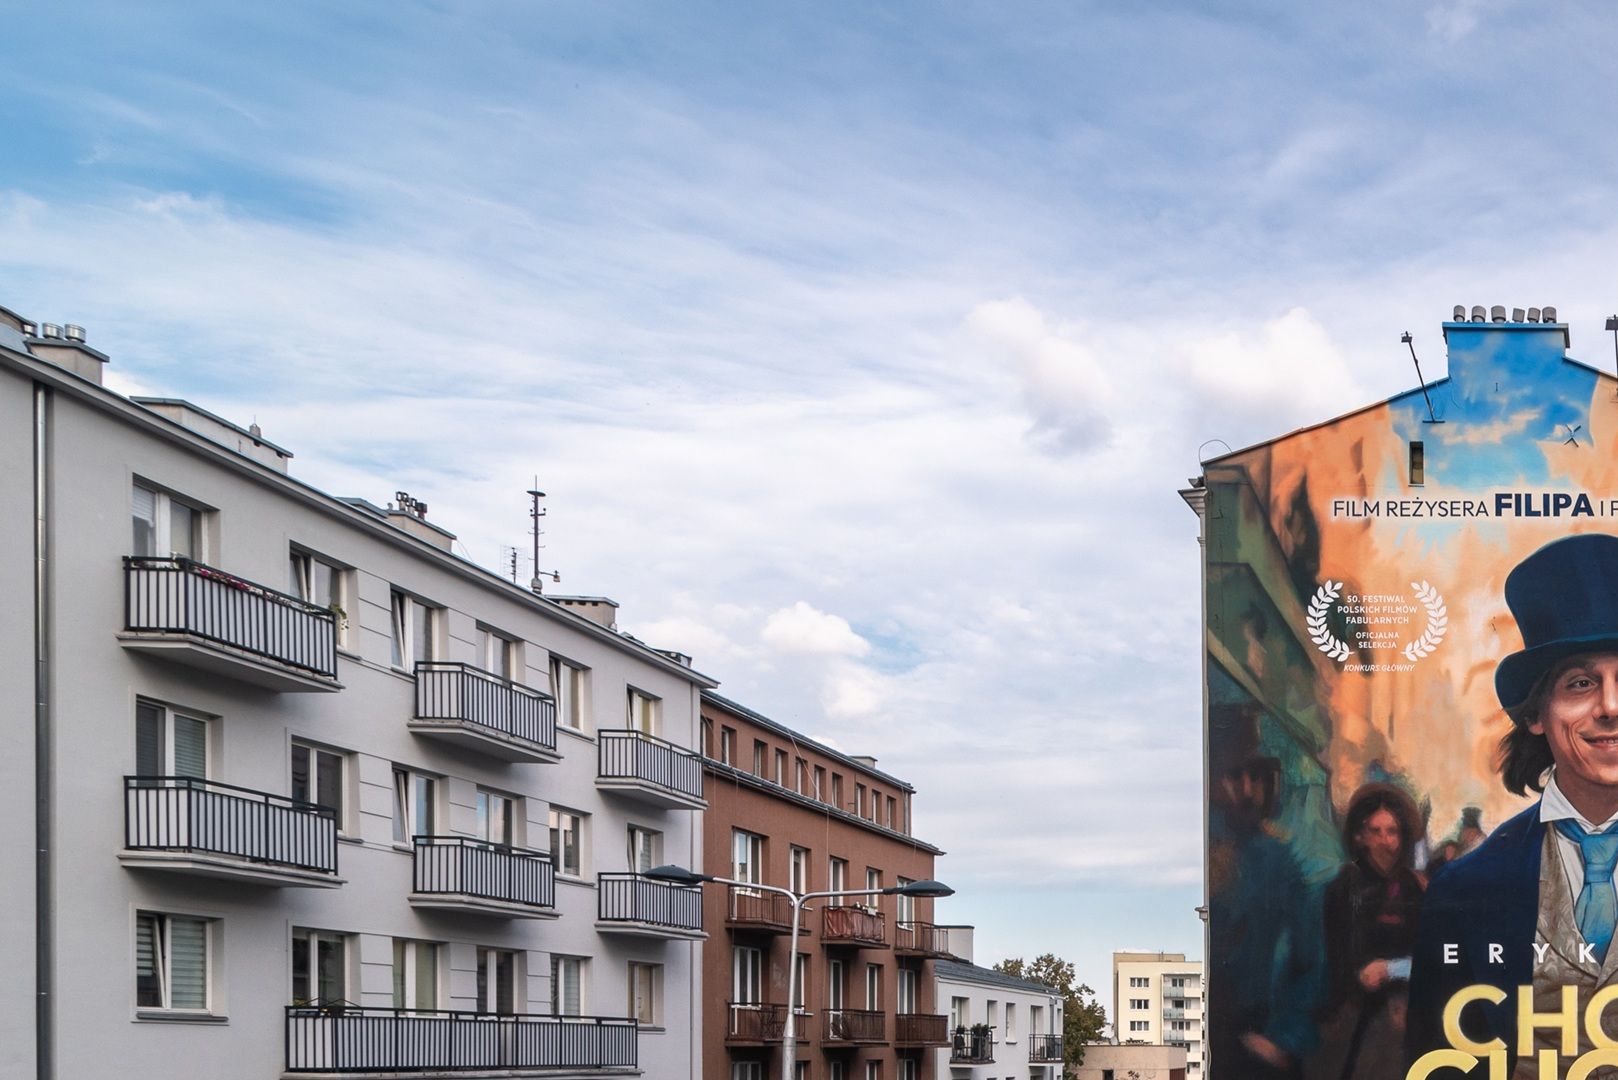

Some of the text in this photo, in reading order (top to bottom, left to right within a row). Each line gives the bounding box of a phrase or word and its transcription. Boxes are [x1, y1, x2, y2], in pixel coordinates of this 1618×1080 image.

[1333, 500, 1380, 517] FILM
[1386, 497, 1488, 517] REŻYSERA
[1495, 493, 1595, 517] FILIPA
[1600, 500, 1604, 517] I
[1362, 595, 1405, 603] FESTIWAL
[1337, 604, 1418, 614] POLSKICH FILMÓW
[1345, 616, 1409, 625] FABULARNYCH
[1355, 631, 1400, 640] OFICJALNA
[1358, 641, 1397, 649] SELEKCJA
[1343, 664, 1380, 672] KONKURS
[1443, 943, 1597, 964] ERYK
